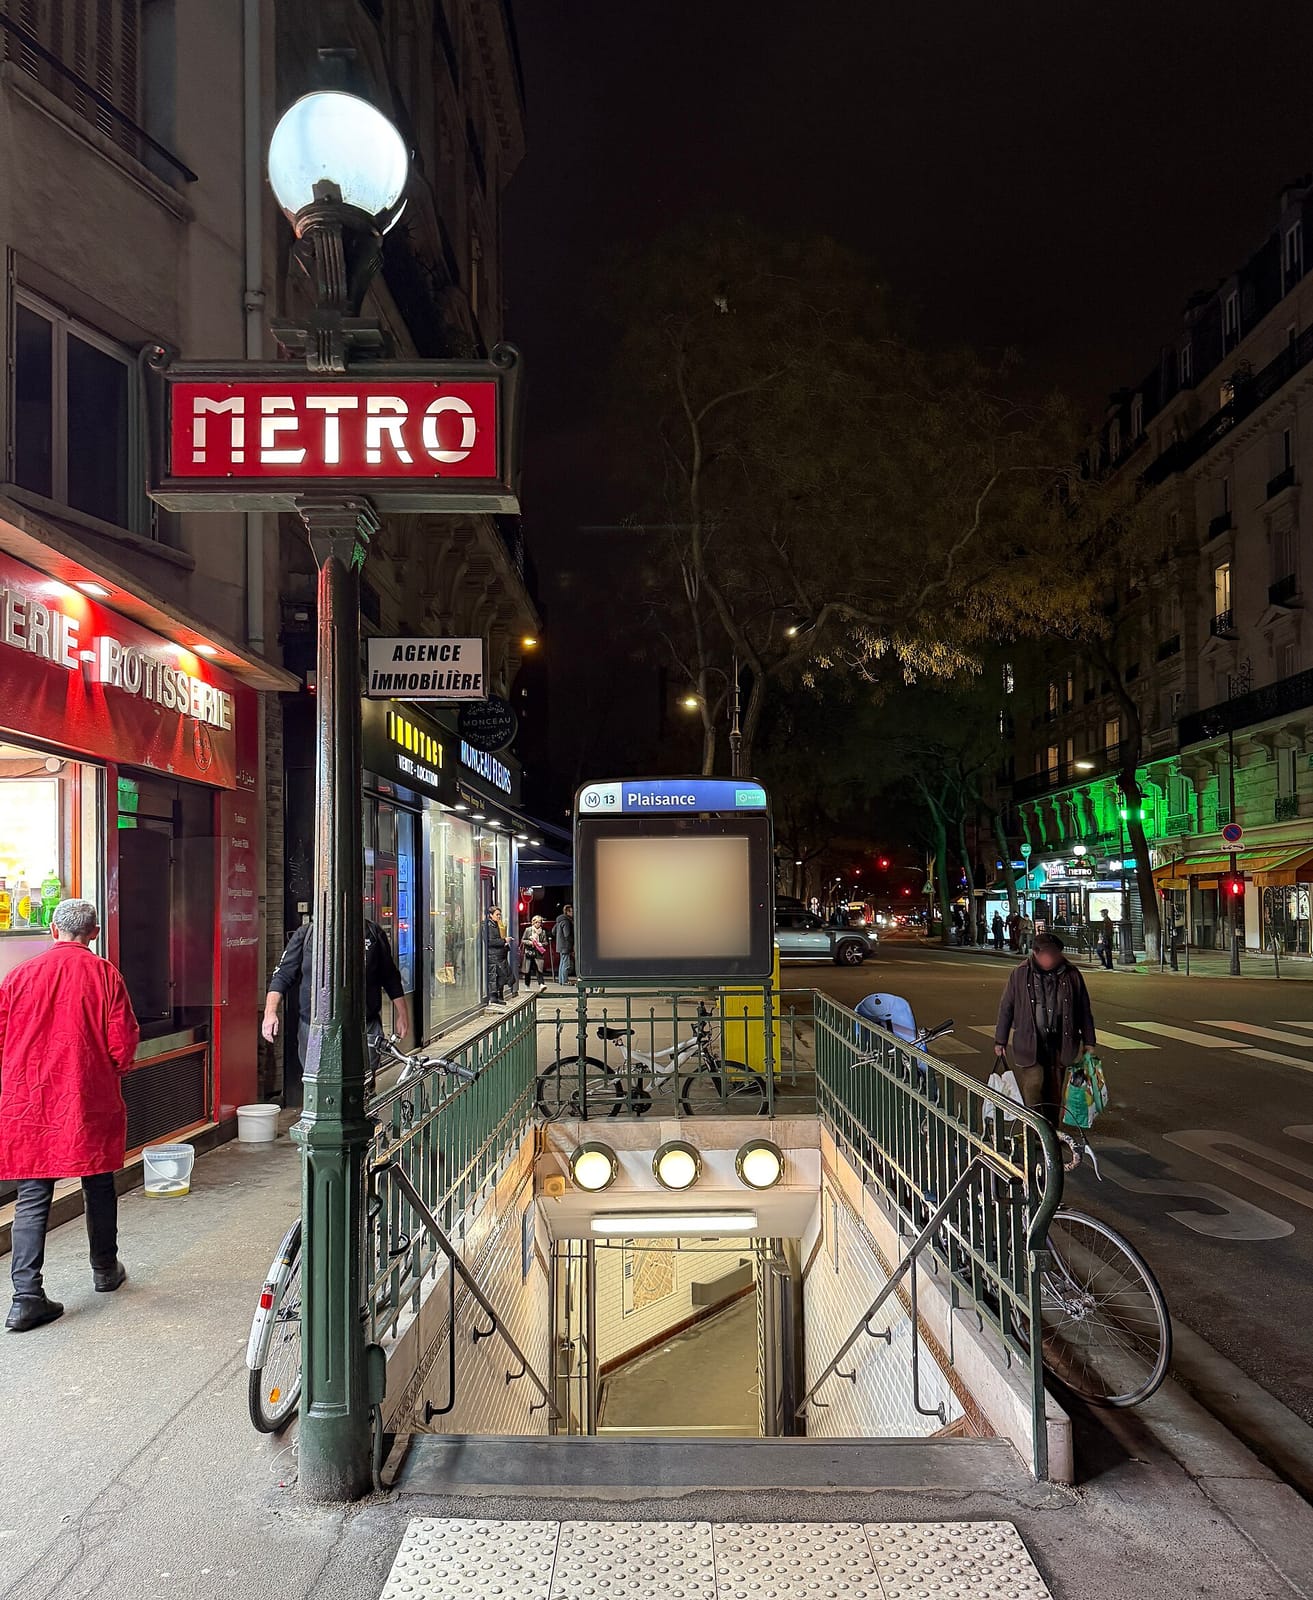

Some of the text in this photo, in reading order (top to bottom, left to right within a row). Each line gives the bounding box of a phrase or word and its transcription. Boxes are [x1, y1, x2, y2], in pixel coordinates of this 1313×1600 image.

[192, 396, 477, 464] METRO
[392, 644, 462, 662] AGENCE
[463, 716, 511, 728] MONCEAU
[602, 795, 616, 805] 13
[627, 793, 696, 806] Plaisance
